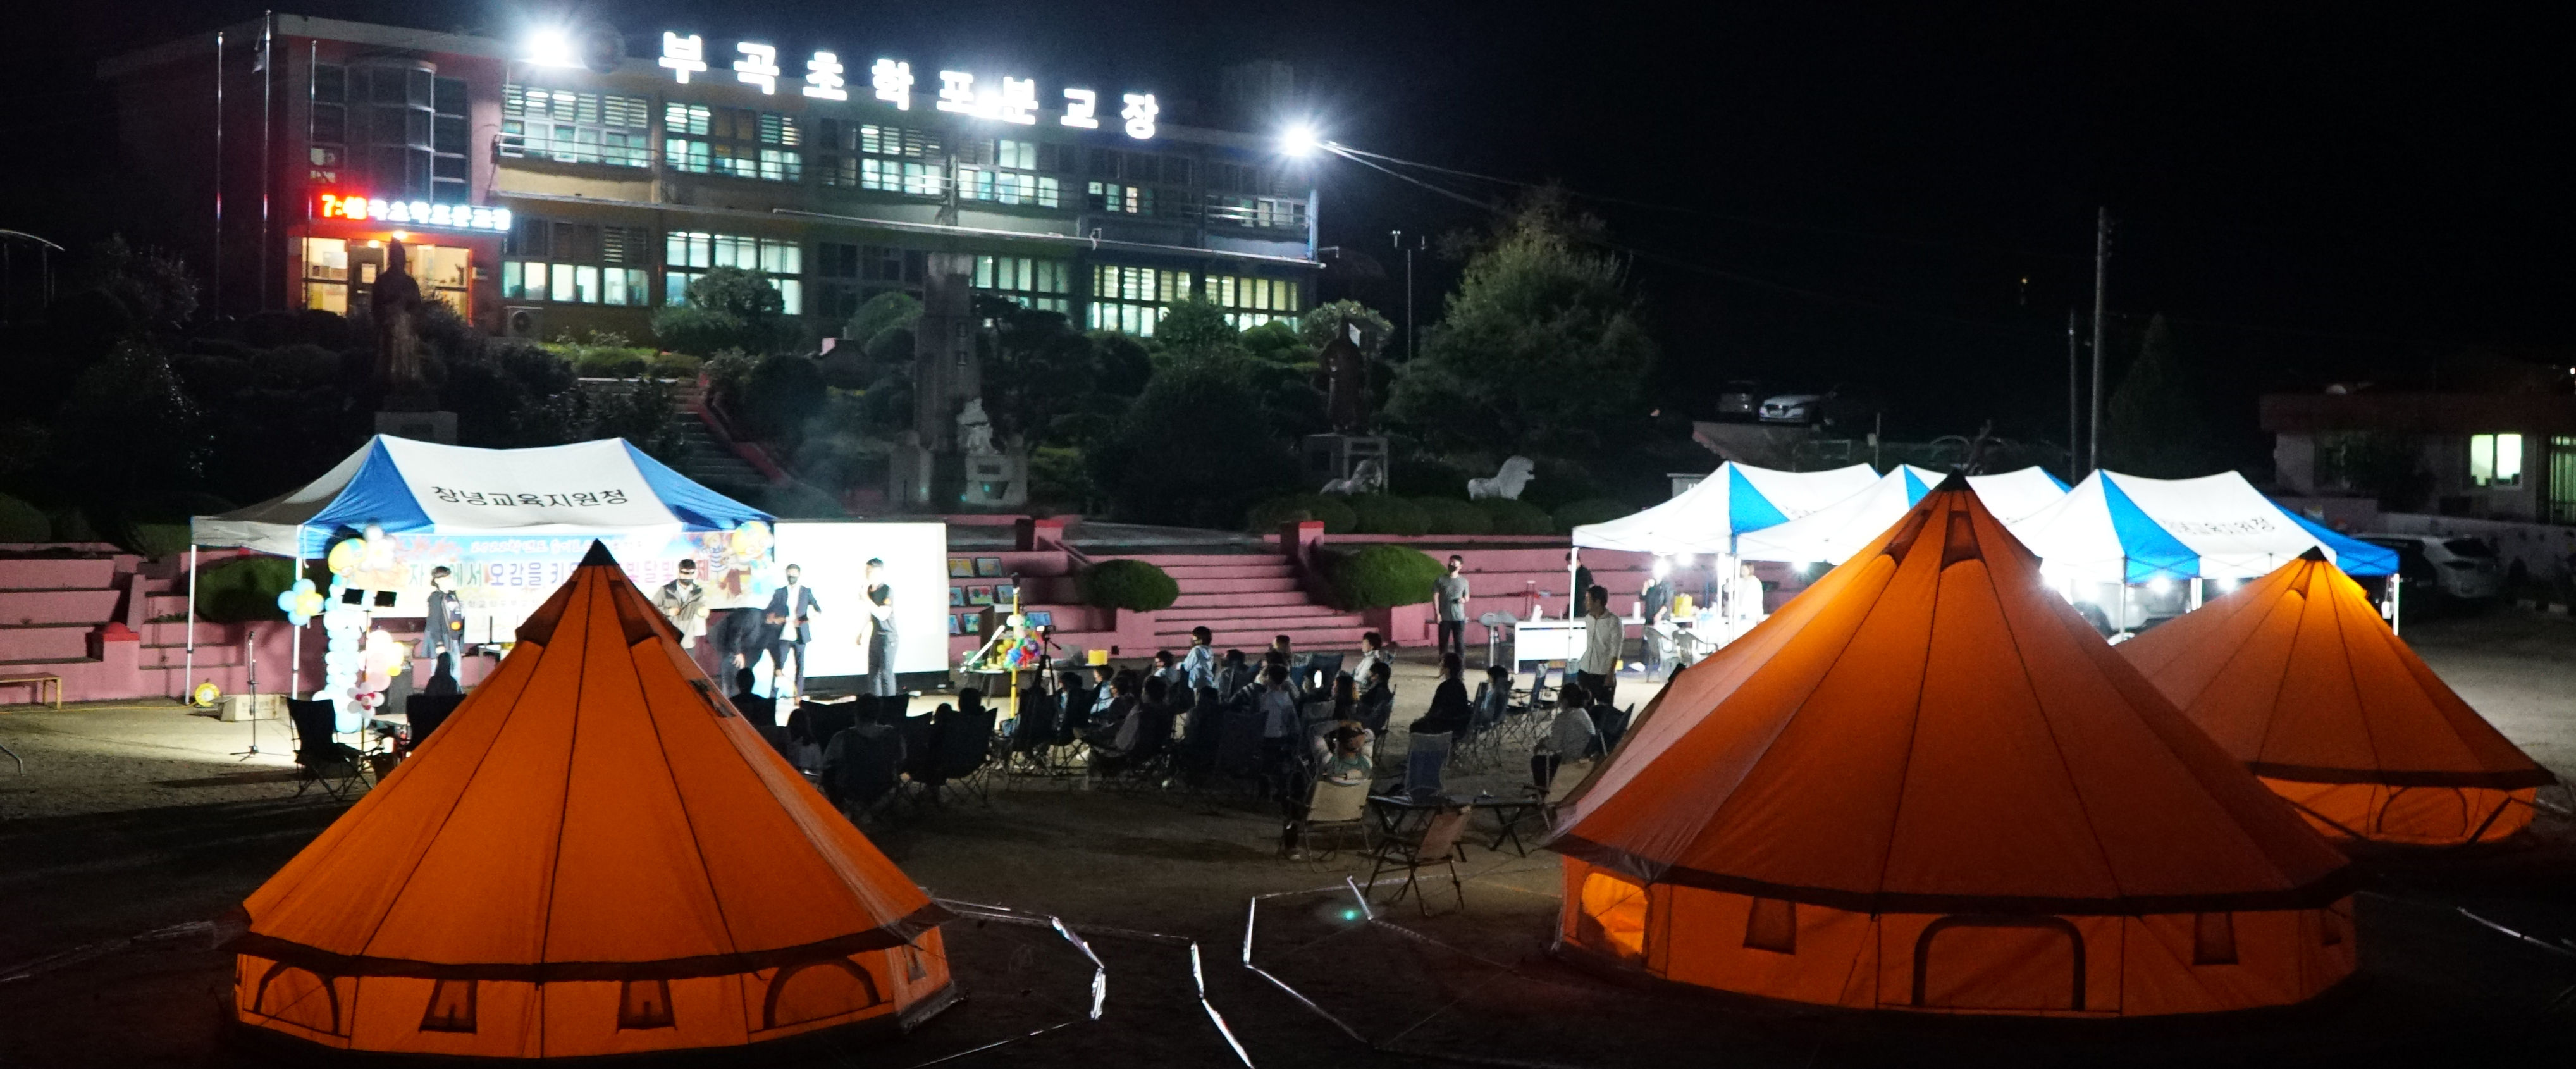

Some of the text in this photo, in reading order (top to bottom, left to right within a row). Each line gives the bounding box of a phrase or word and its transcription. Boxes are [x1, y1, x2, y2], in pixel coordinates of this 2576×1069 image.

[431, 485, 628, 507] 창녕교육지원청
[409, 561, 483, 587] 자에서
[490, 562, 542, 586] 오감을
